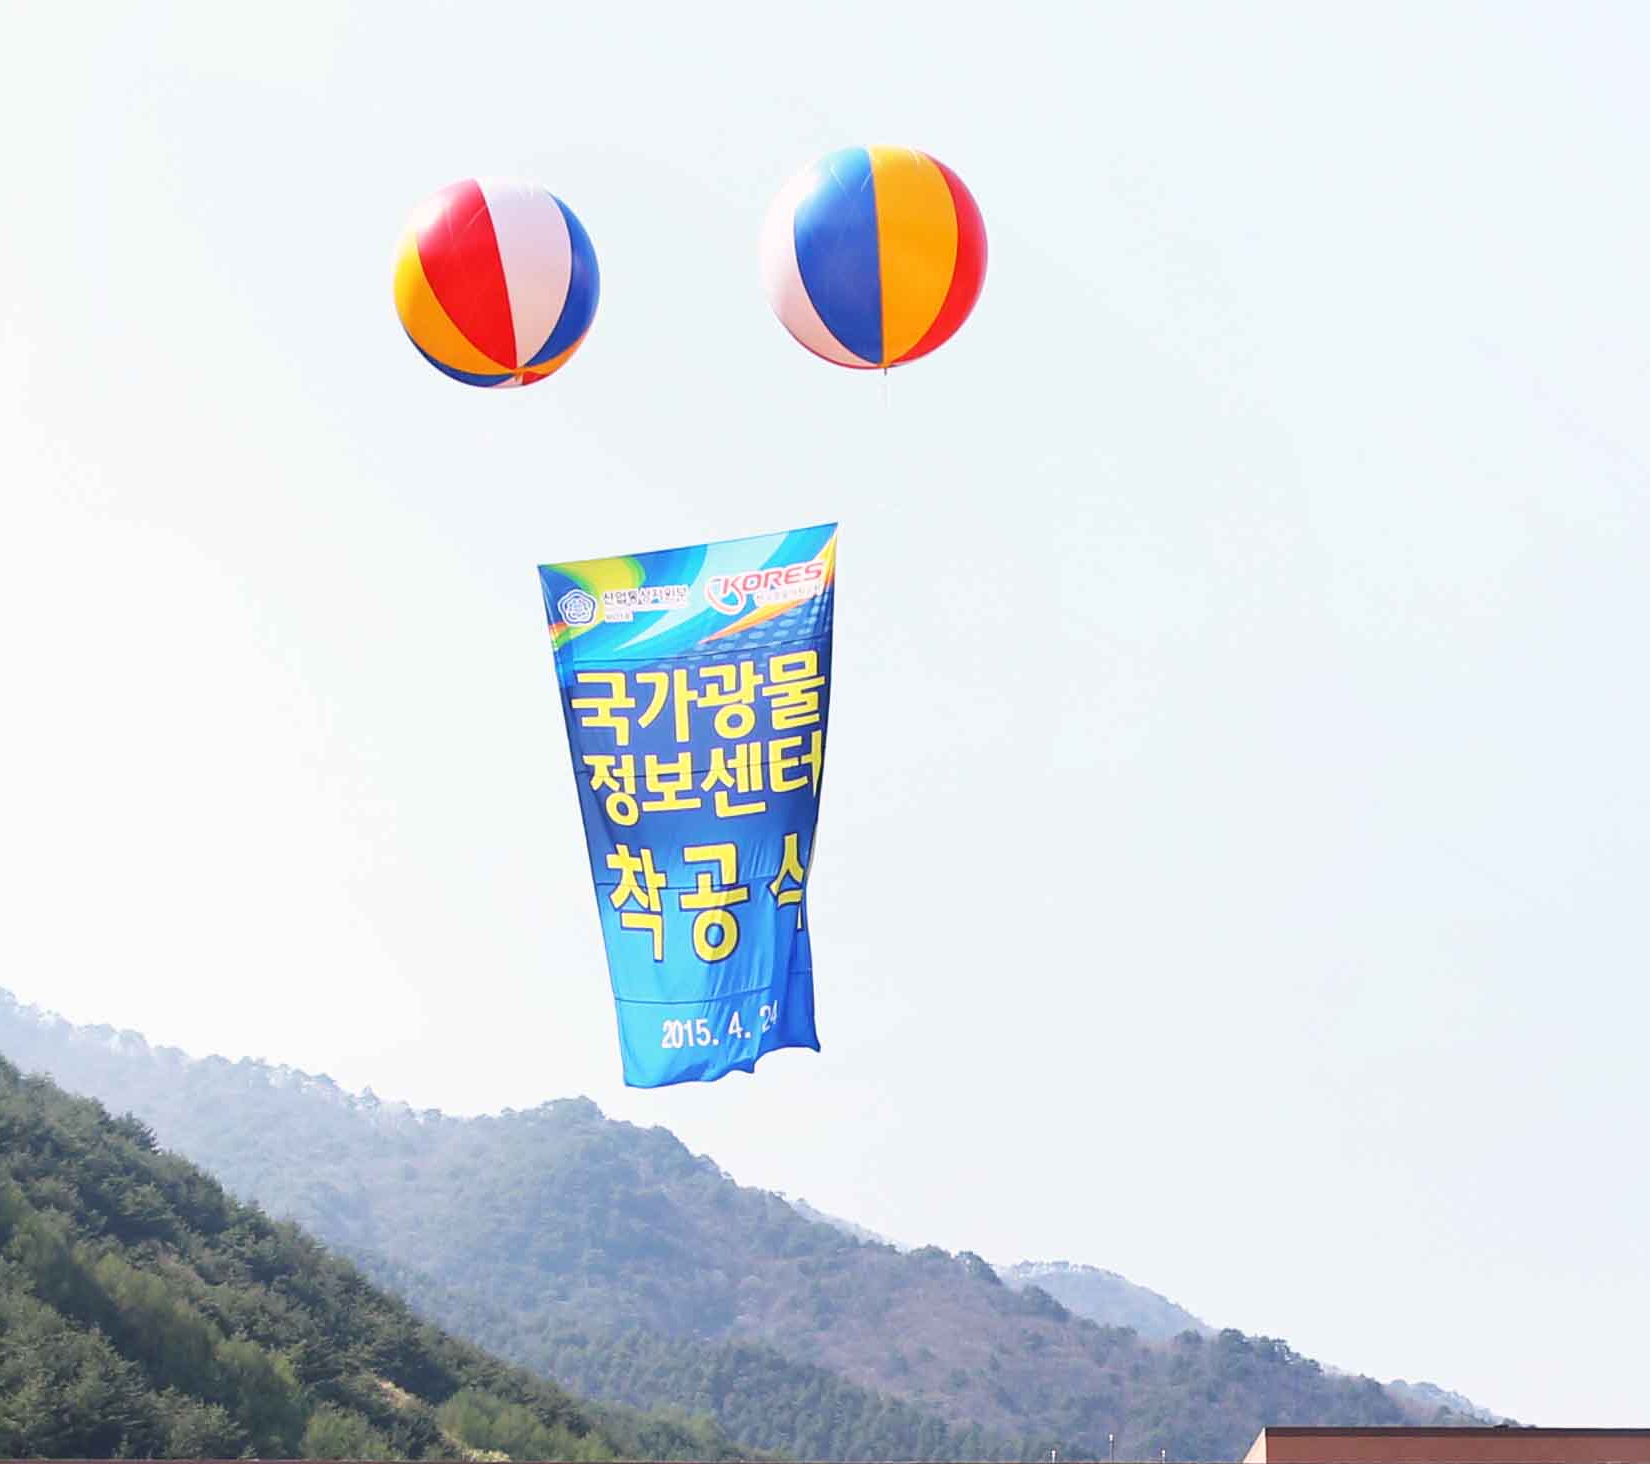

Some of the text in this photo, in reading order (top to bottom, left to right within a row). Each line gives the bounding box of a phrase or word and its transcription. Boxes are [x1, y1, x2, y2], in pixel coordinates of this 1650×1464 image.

[713, 560, 825, 604] KORES
[571, 650, 826, 747] 국가광물
[582, 730, 824, 827] 정보센터
[660, 1018, 720, 1050] 2015.
[727, 1010, 752, 1039] 4.
